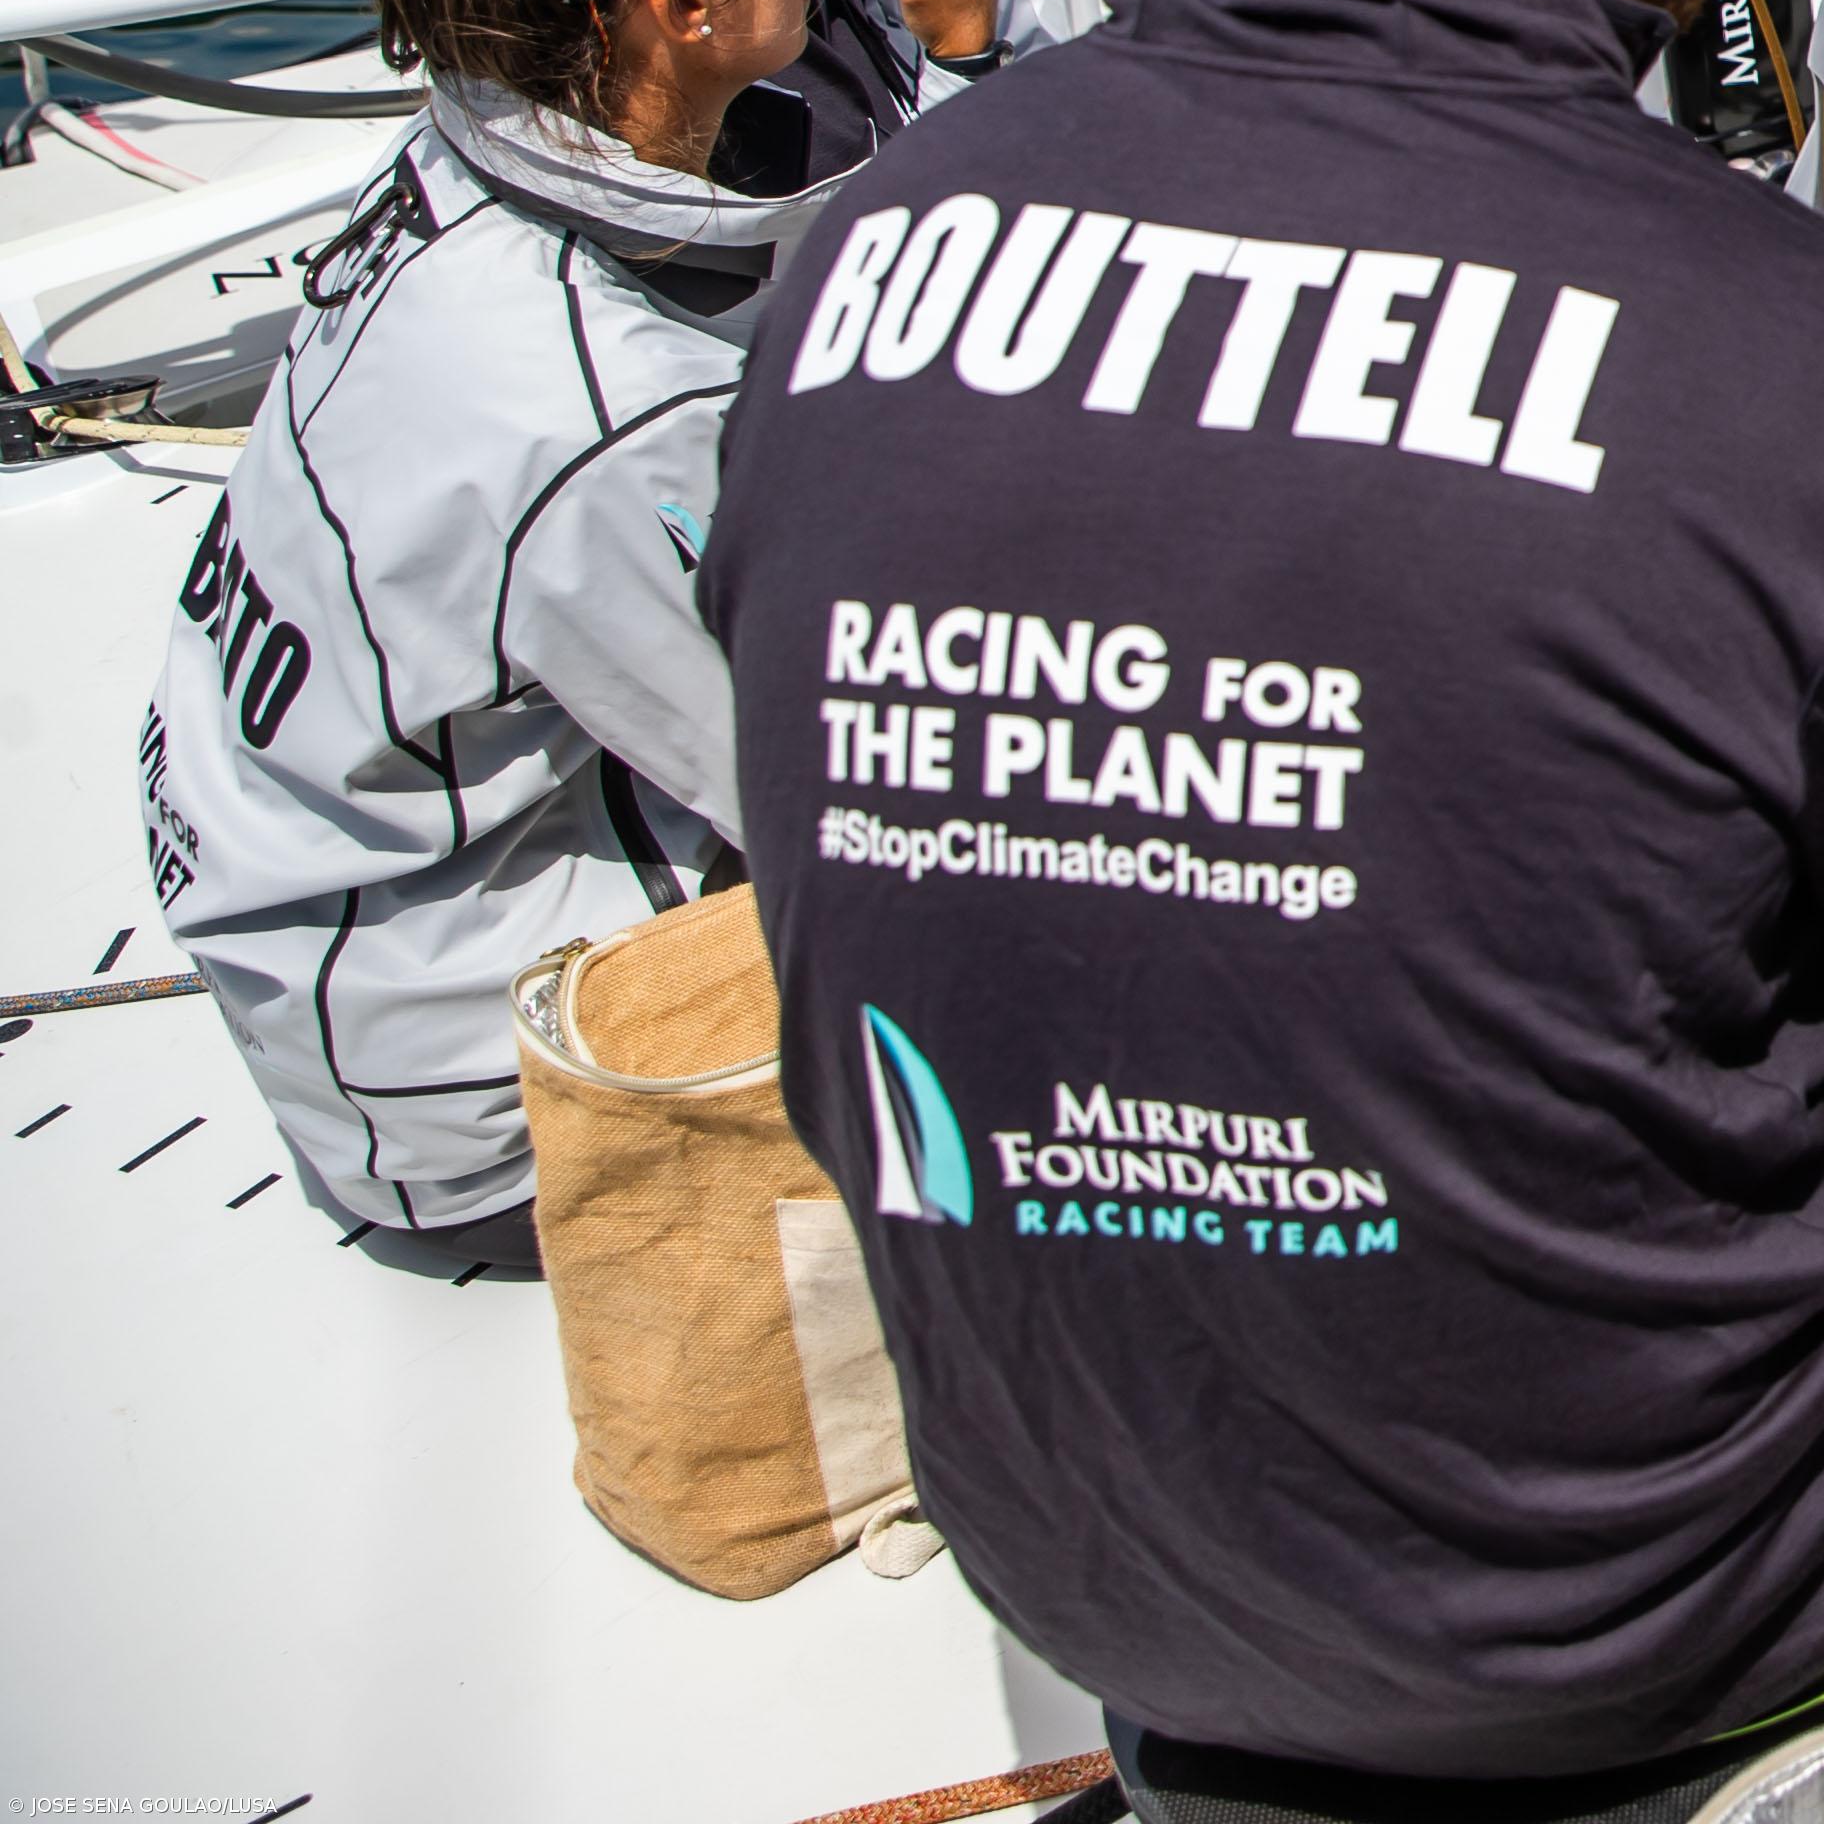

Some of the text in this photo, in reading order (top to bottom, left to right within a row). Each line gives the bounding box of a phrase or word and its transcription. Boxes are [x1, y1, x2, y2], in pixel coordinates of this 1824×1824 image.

[787, 192, 1619, 493] BOUTTELL
[825, 600, 1363, 732] RACING FOR
[820, 698, 1364, 831] THE PLANET
[158, 797, 200, 863] FOR
[818, 808, 1357, 920] #StopClimateChange
[990, 1129, 1389, 1210] FOUNDATION
[1054, 1081, 1315, 1162] MIRPURI
[1016, 1197, 1400, 1258] RACING TEAM
